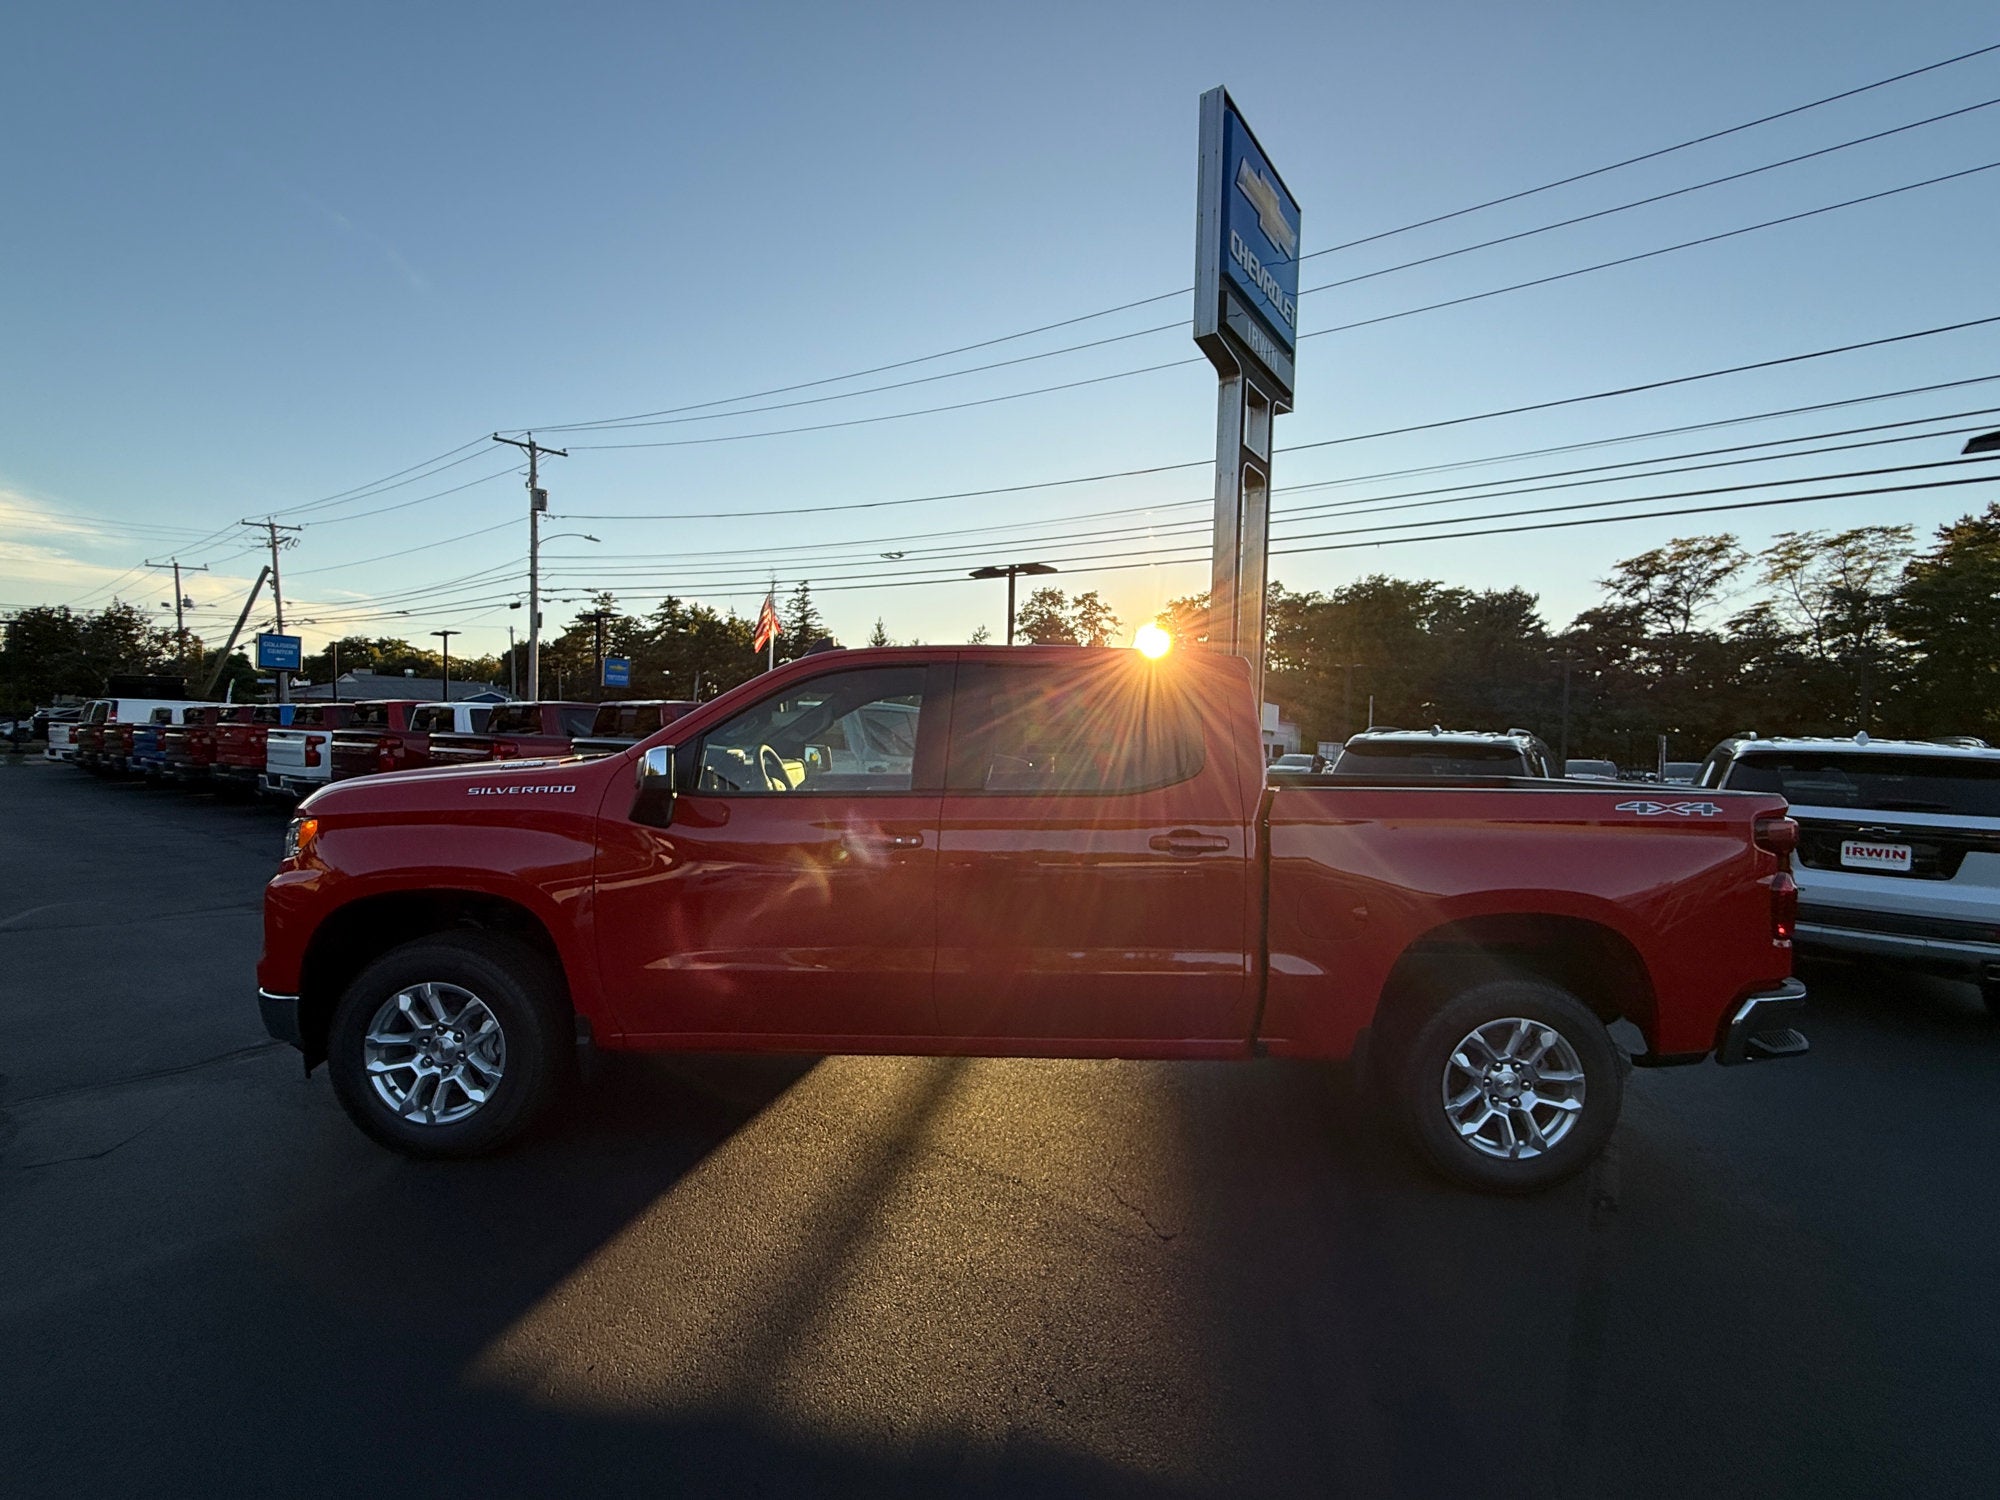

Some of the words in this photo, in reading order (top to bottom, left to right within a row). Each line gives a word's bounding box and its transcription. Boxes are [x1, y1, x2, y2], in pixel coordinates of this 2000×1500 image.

[1230, 228, 1296, 329] CHEVROLET
[1247, 320, 1279, 372] IRWIN
[467, 785, 576, 796] SILVERADO
[1845, 846, 1907, 860] IRWIN
